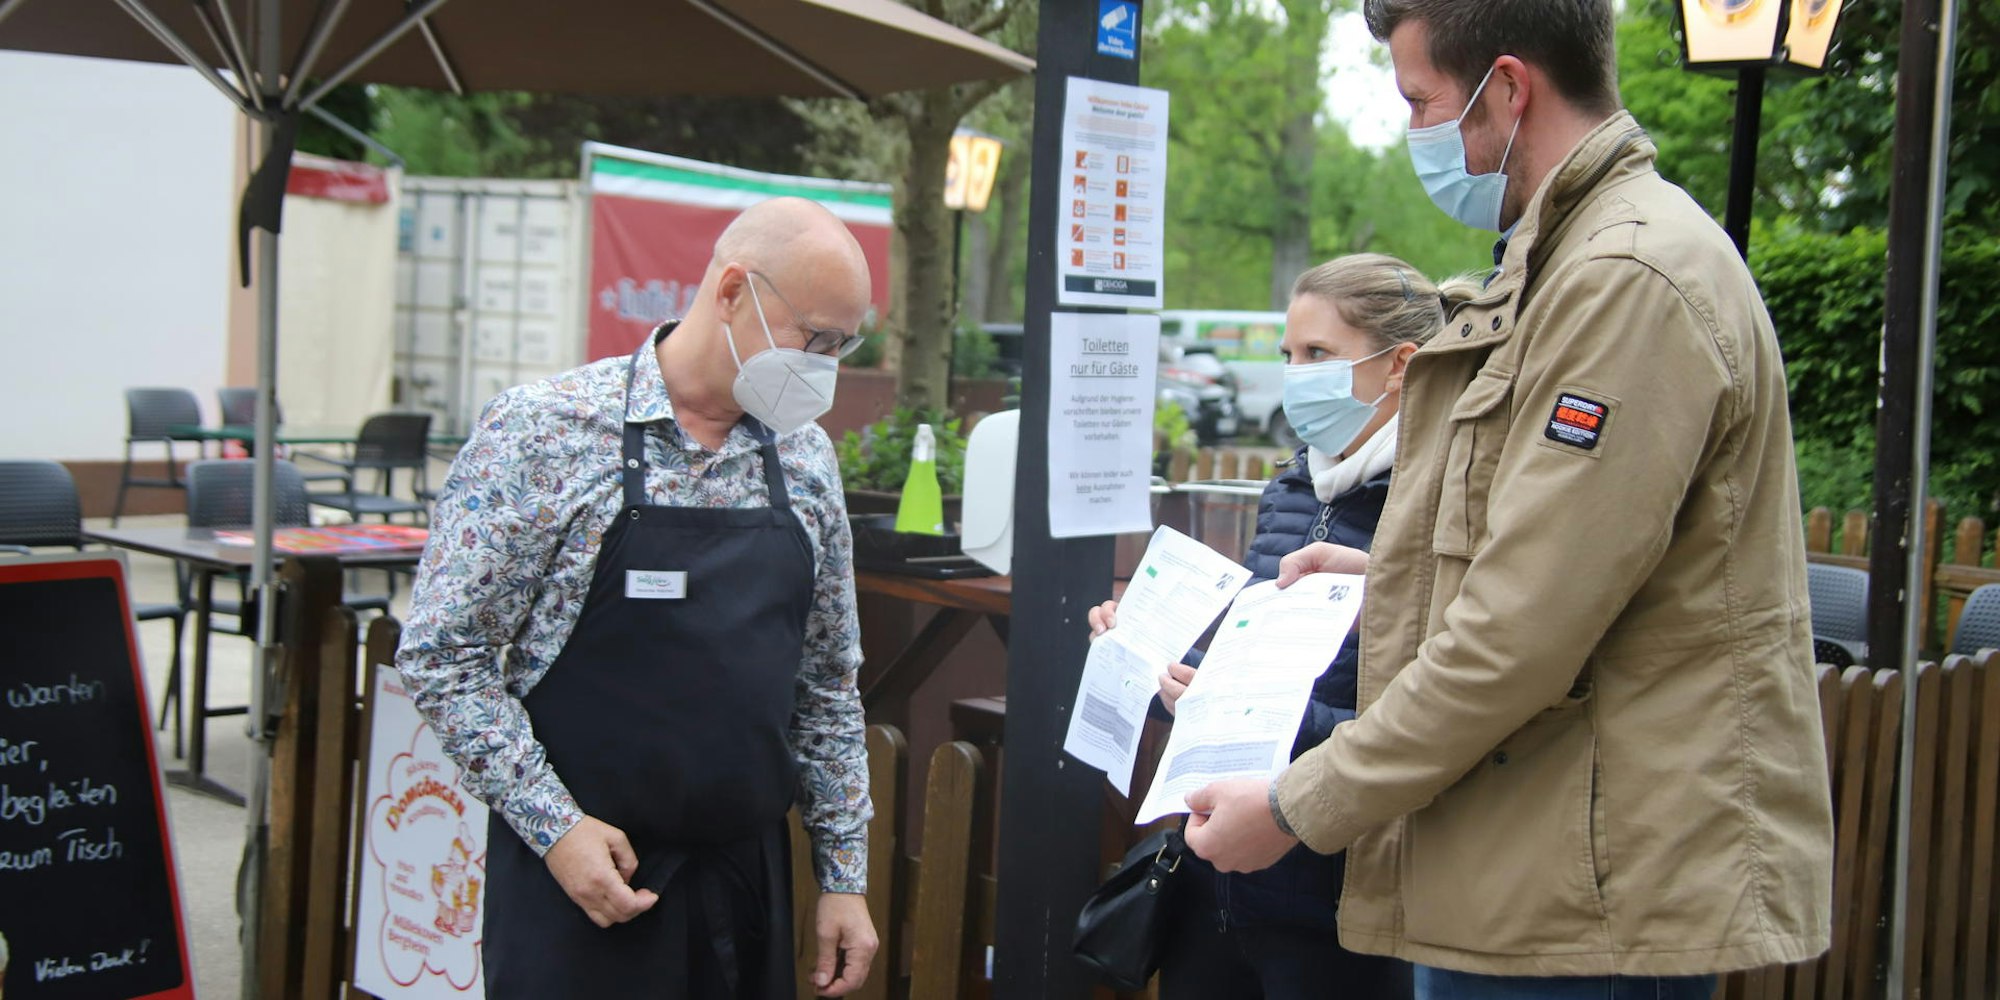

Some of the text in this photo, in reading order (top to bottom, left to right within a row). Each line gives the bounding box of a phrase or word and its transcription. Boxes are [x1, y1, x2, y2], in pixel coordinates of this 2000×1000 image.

[1082, 338, 1129, 353] Toiletten
[1070, 360, 1139, 376] nur für Gäste
[1071, 394, 1099, 404] Aufgrund
[1100, 394, 1111, 402] der
[1561, 396, 1597, 411] SUPERDRY
[1073, 420, 1099, 428] Toiletten
[1069, 472, 1079, 480] Wir
[1120, 470, 1134, 478] auch
[7, 673, 105, 708] warten
[0, 778, 117, 825] begleiten
[56, 827, 123, 862] Tisch
